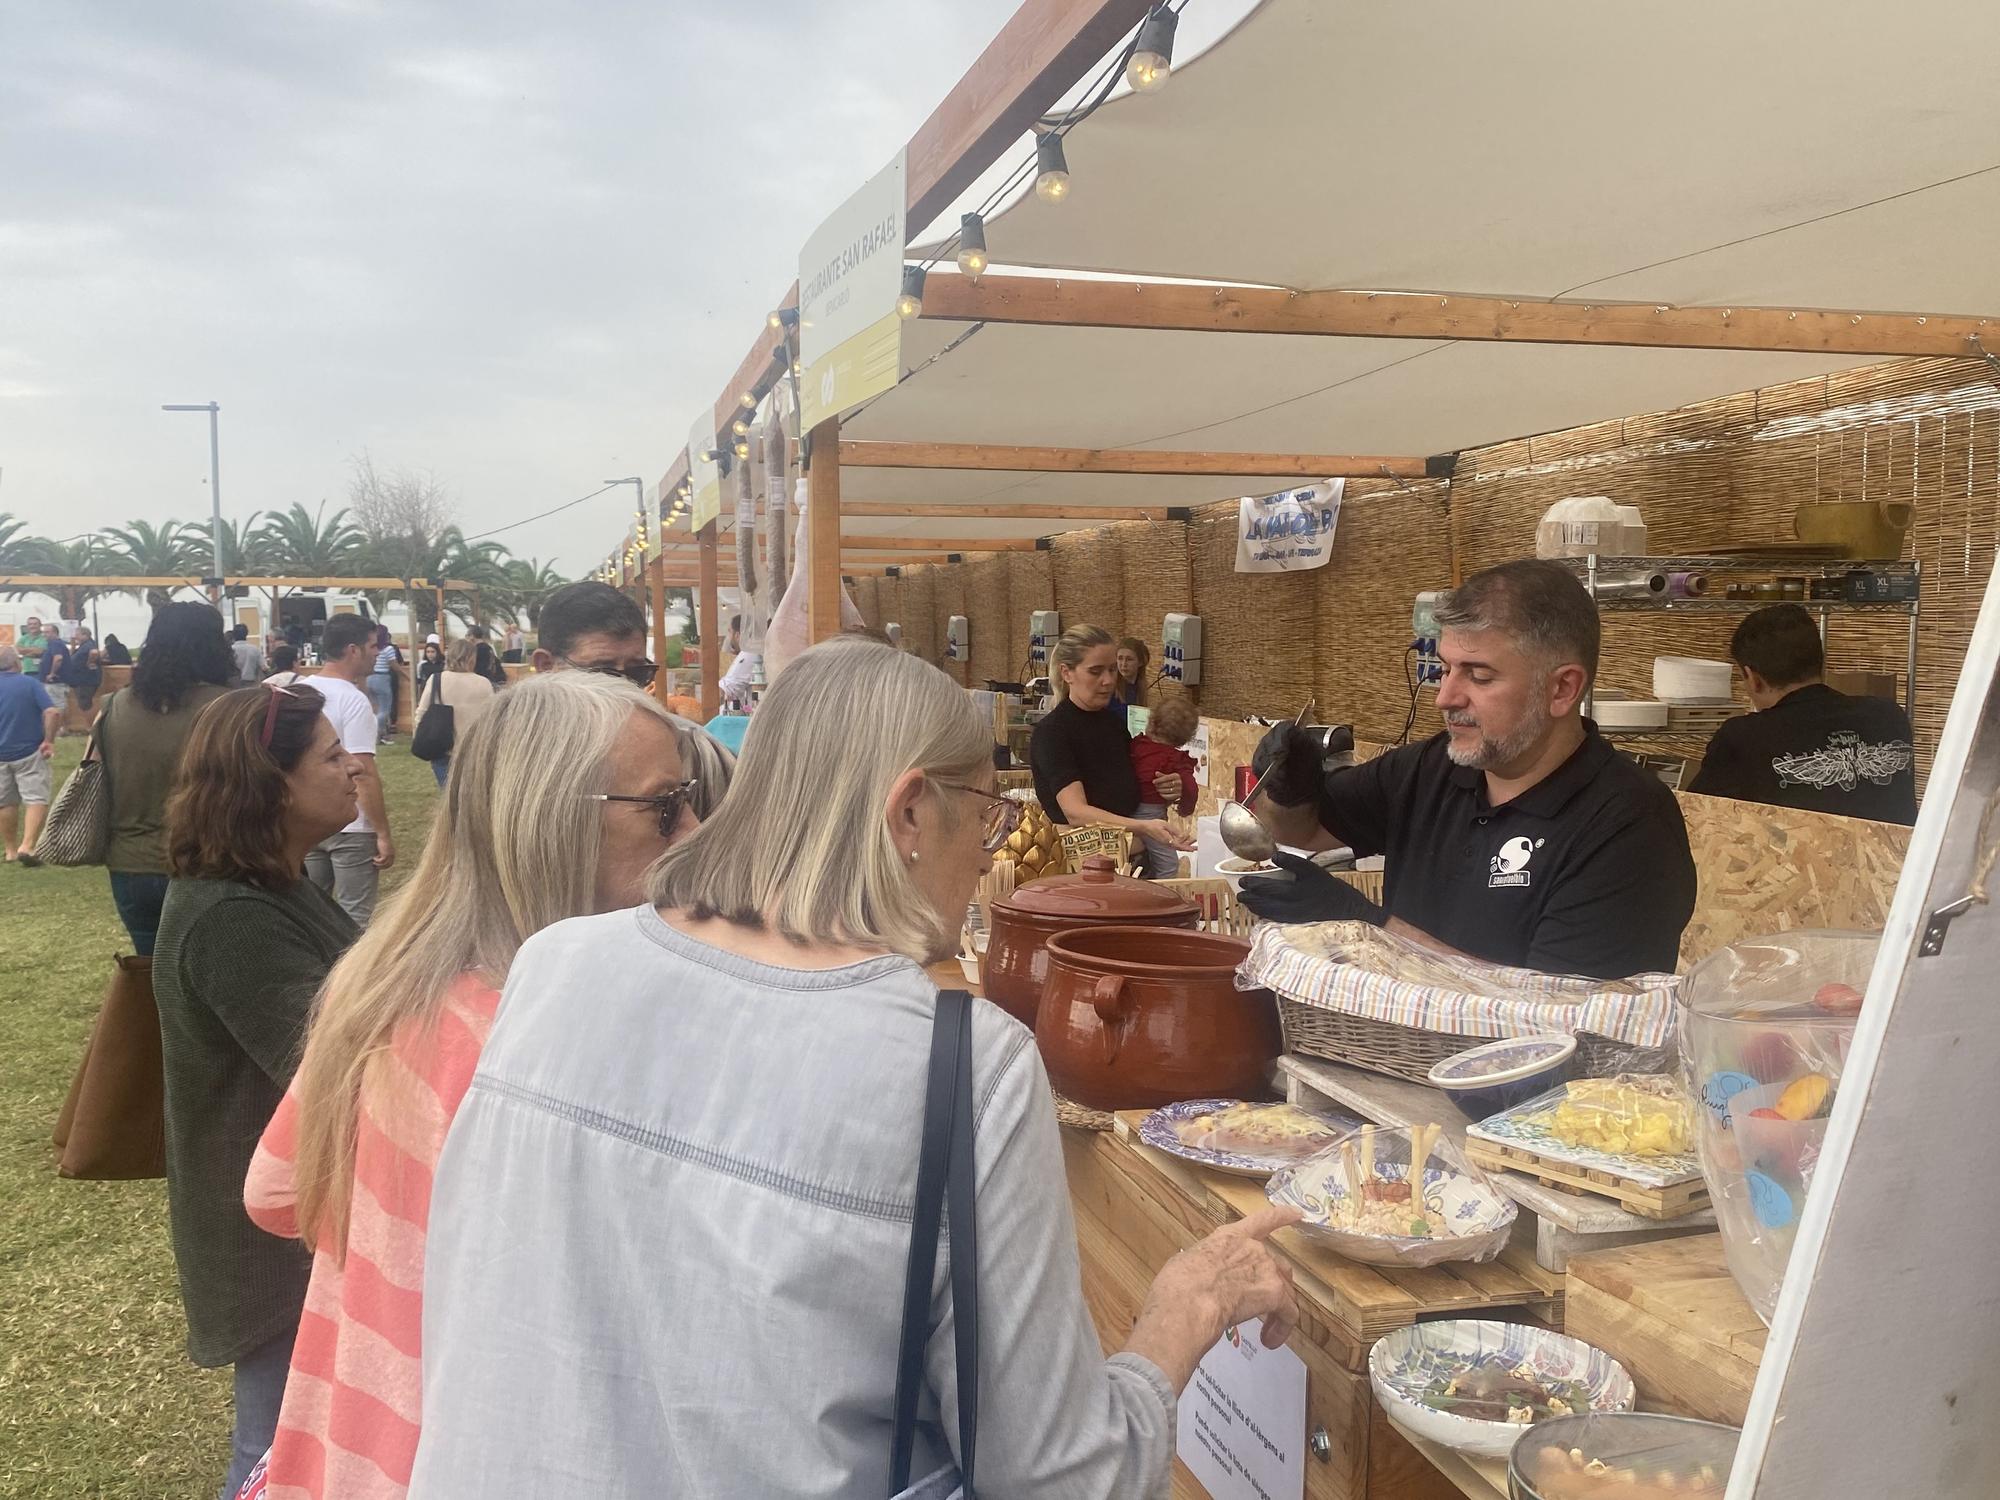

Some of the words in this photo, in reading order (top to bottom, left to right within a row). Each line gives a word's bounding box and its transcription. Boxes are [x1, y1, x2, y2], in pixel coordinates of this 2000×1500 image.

[842, 239, 860, 276] SAN
[862, 212, 897, 262] RAFAEL
[1855, 581, 1866, 590] XL
[1877, 577, 1889, 587] XL
[1064, 835, 1074, 846] 10
[1074, 830, 1099, 843] 100%
[1211, 1398, 1231, 1426] personal
[1226, 1394, 1232, 1407] la
[1232, 1400, 1244, 1422] llista
[1279, 1452, 1285, 1463] al
[1195, 1410, 1209, 1434] Puede
[1209, 1430, 1227, 1454] solicitar
[1228, 1448, 1232, 1460] la
[1233, 1454, 1243, 1473] lista
[1244, 1468, 1250, 1481] de
[1212, 1448, 1232, 1476] personal
